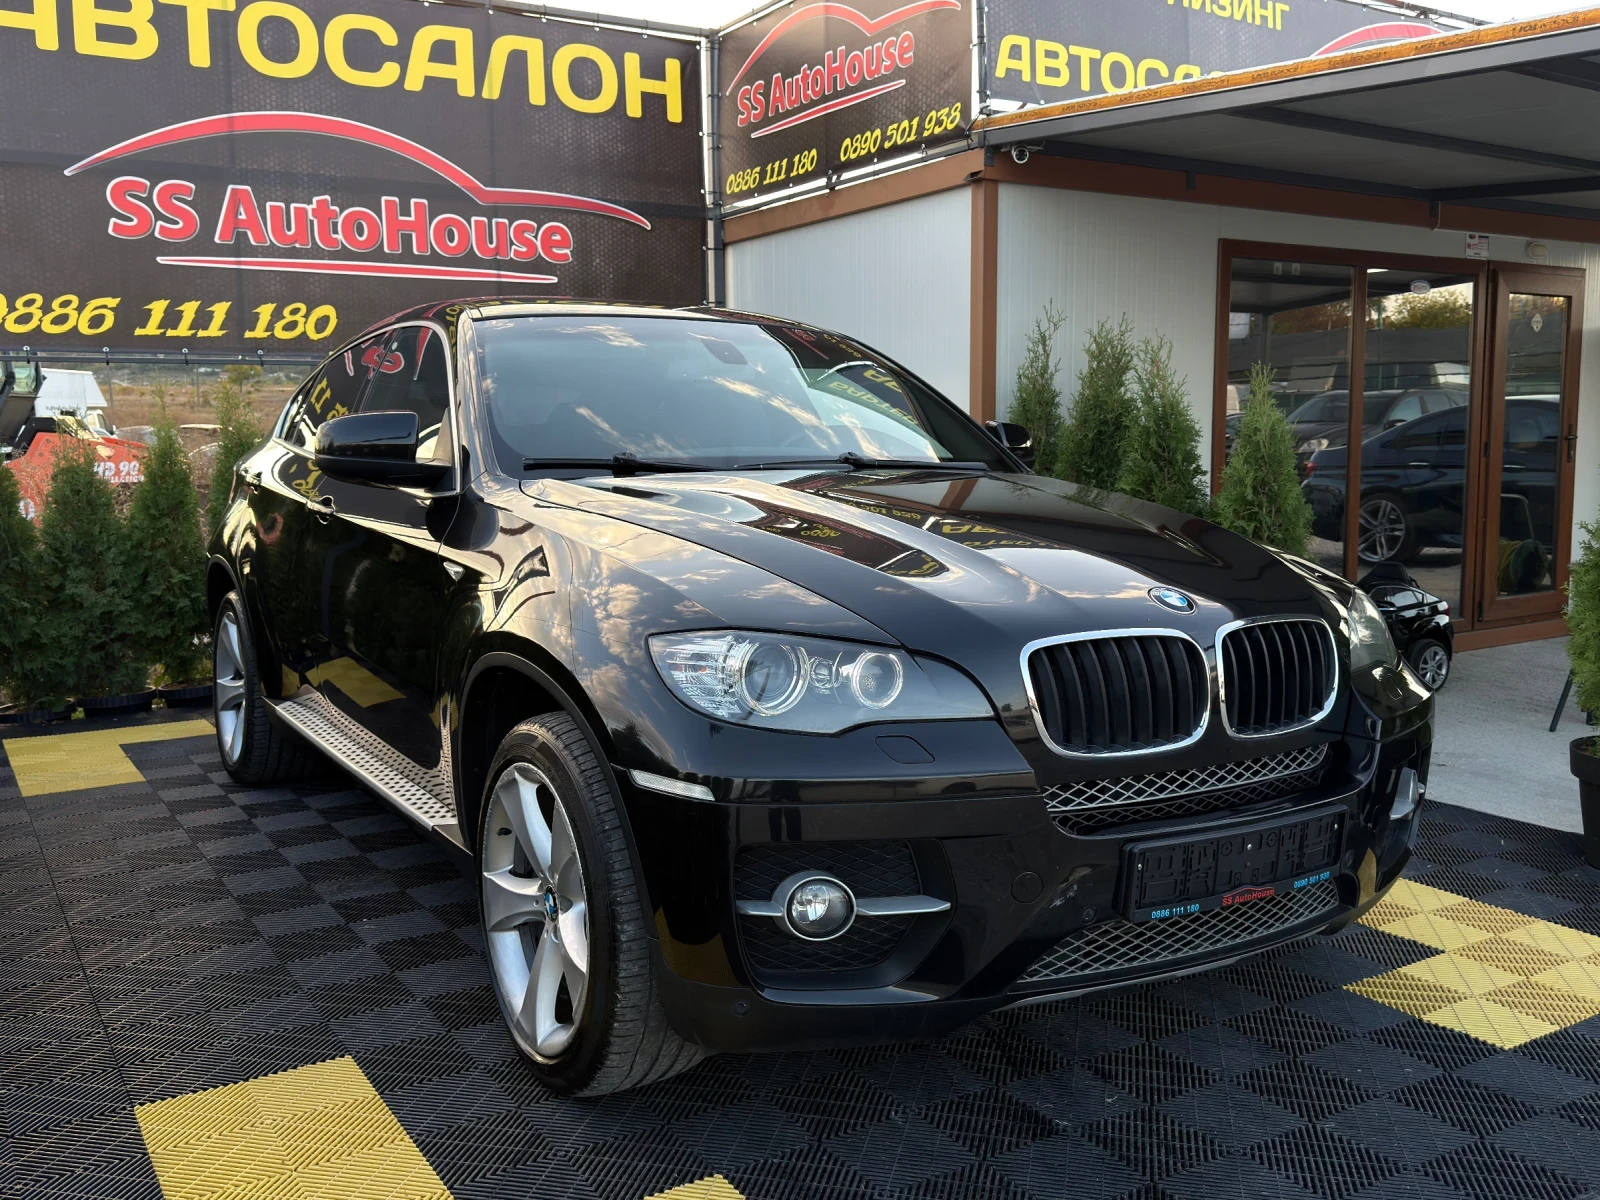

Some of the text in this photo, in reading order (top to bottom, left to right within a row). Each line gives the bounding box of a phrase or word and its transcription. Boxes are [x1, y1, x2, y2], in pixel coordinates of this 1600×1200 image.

[1167, 0, 1290, 31] ЗИНГ
[737, 31, 915, 127] SS AutoHouse
[995, 34, 1230, 95] АВТОС
[840, 102, 961, 162] 0890 501 938
[725, 148, 818, 195] 0886 111 180
[106, 176, 574, 264] SS AutoHouse
[0, 292, 339, 341] 886 111 180
[1151, 903, 1200, 919] 0886 111 180
[1222, 888, 1275, 906] SS AutoHouse
